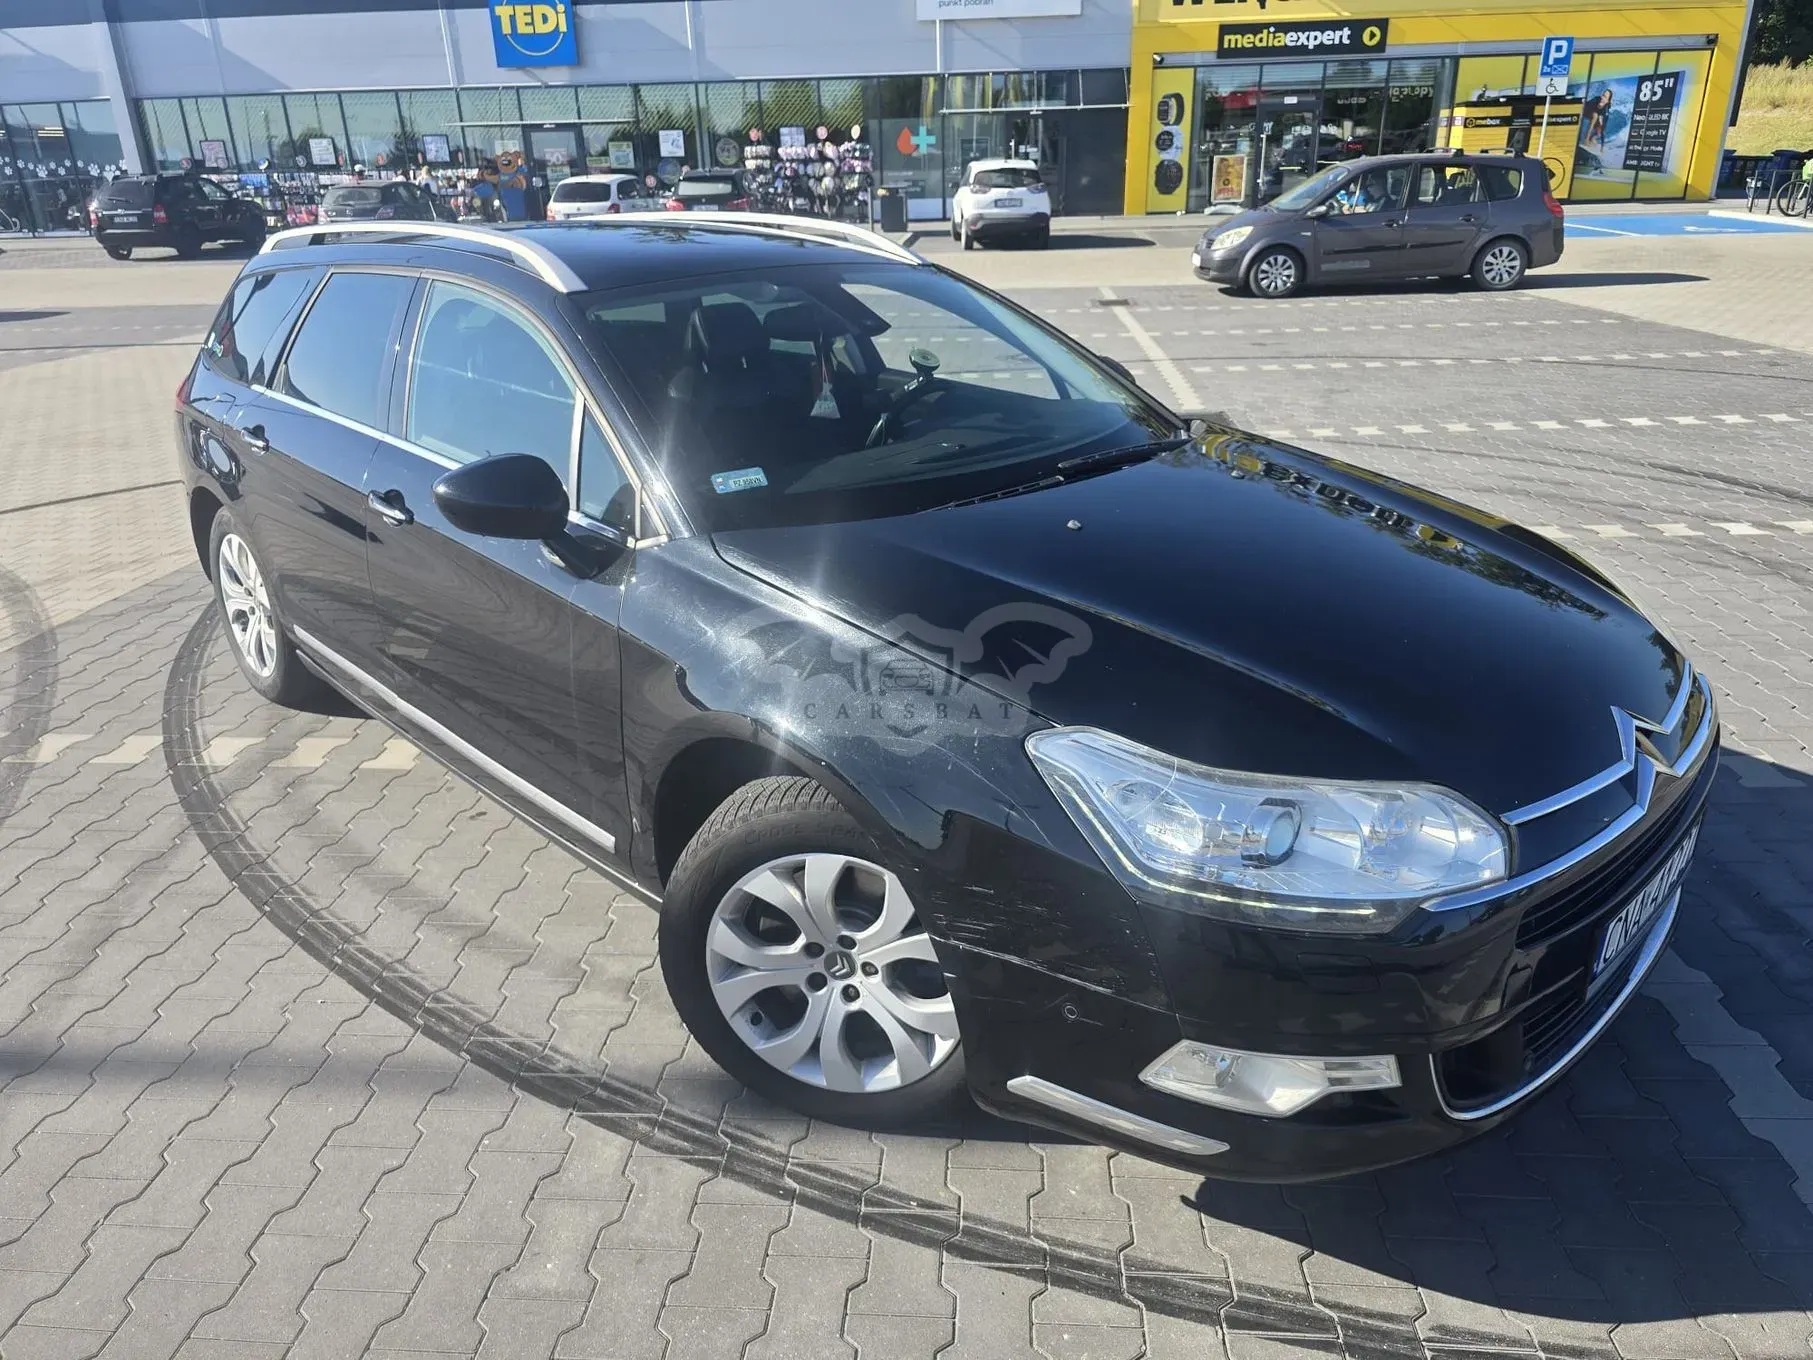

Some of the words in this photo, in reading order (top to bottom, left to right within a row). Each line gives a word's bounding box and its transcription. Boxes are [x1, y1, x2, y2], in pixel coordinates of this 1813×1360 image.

[494, 3, 568, 35] TEDi
[1223, 26, 1351, 50] mediaexpert
[1548, 40, 1569, 65] P
[1639, 77, 1675, 102] 85"
[1603, 890, 1646, 964] CNA
